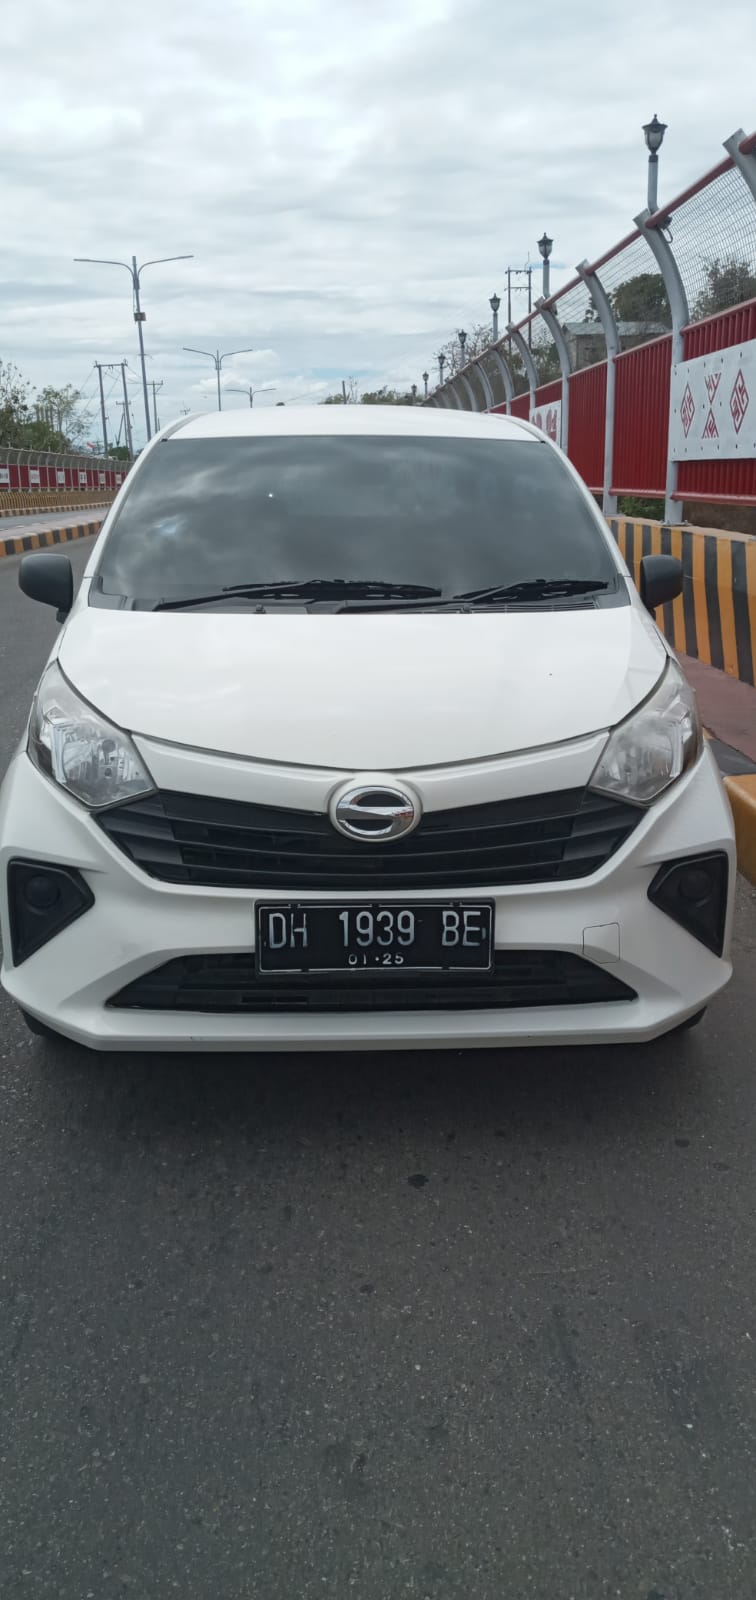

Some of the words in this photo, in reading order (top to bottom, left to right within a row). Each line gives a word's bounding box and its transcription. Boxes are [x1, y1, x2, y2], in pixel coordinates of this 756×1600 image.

[268, 912, 308, 949] DH
[339, 910, 415, 947] 1939
[441, 910, 481, 947] BE
